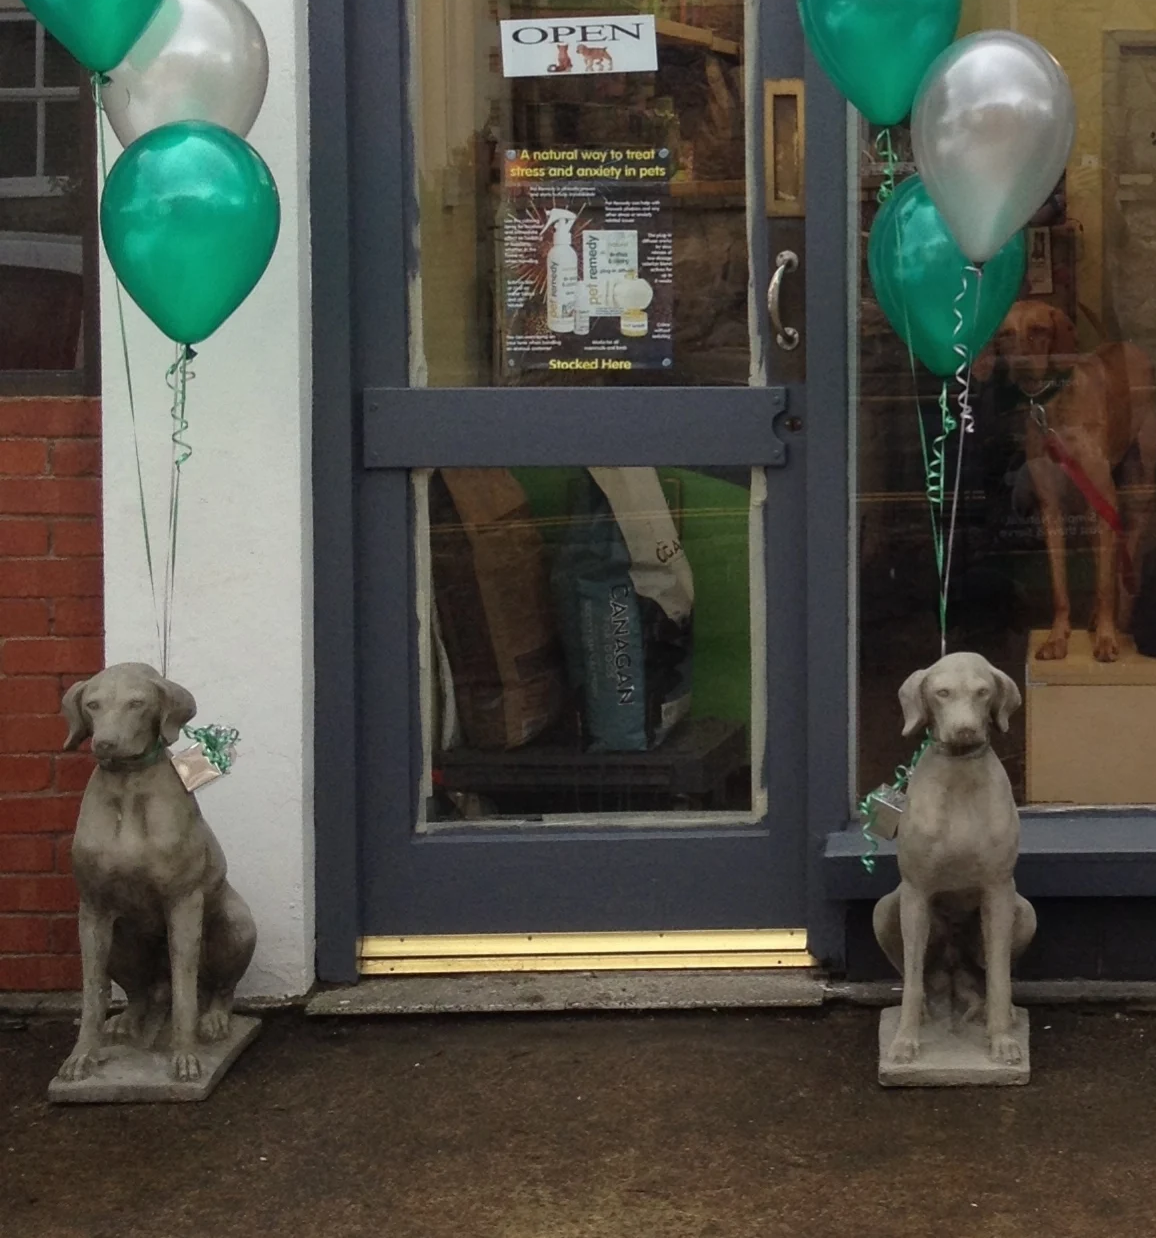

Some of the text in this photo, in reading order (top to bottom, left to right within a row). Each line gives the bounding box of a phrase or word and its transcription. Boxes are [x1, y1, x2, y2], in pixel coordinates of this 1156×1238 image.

[512, 23, 644, 46] OPEN
[520, 149, 655, 163] A natural way to treat
[510, 165, 666, 179] stress and anxiety in pets
[586, 235, 599, 280] remedy
[549, 358, 632, 369] Stocked Here
[608, 583, 636, 707] CANAGAN
